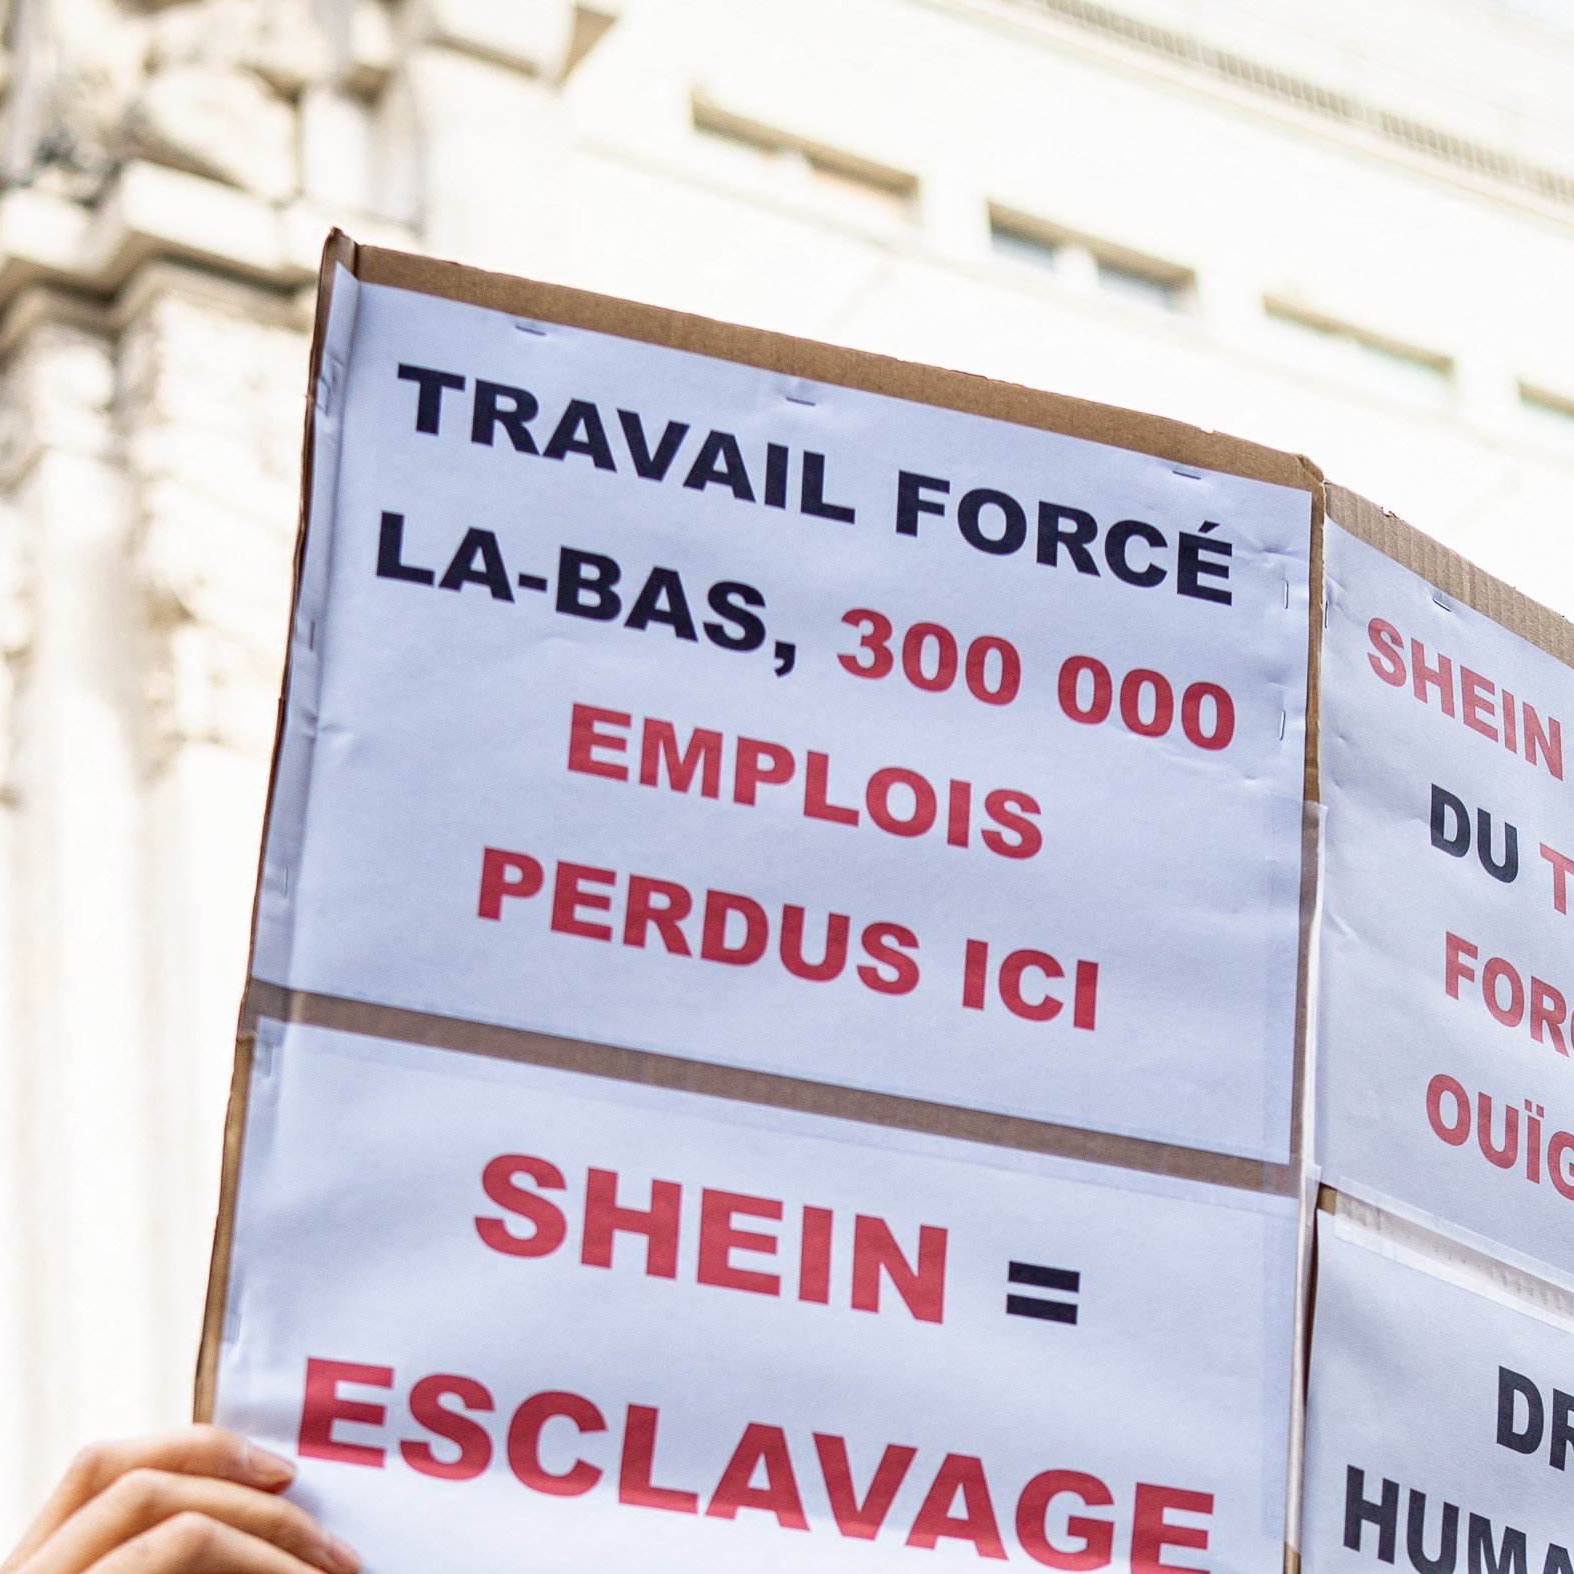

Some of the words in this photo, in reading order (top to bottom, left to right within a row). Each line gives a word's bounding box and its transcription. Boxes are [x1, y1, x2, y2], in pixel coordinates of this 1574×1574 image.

[397, 363, 856, 524] TRAVAIL
[895, 469, 1233, 607] FORCÉ
[375, 510, 797, 677] LA-BAS,
[838, 608, 1021, 706] 300
[1057, 655, 1235, 751] 000
[1368, 619, 1562, 780] SHEIN
[567, 703, 1042, 859] EMPLOIS
[1429, 783, 1519, 884] DU
[477, 847, 920, 996] PERDUS
[962, 938, 1099, 1031] ICI
[474, 1153, 948, 1324] SHEIN
